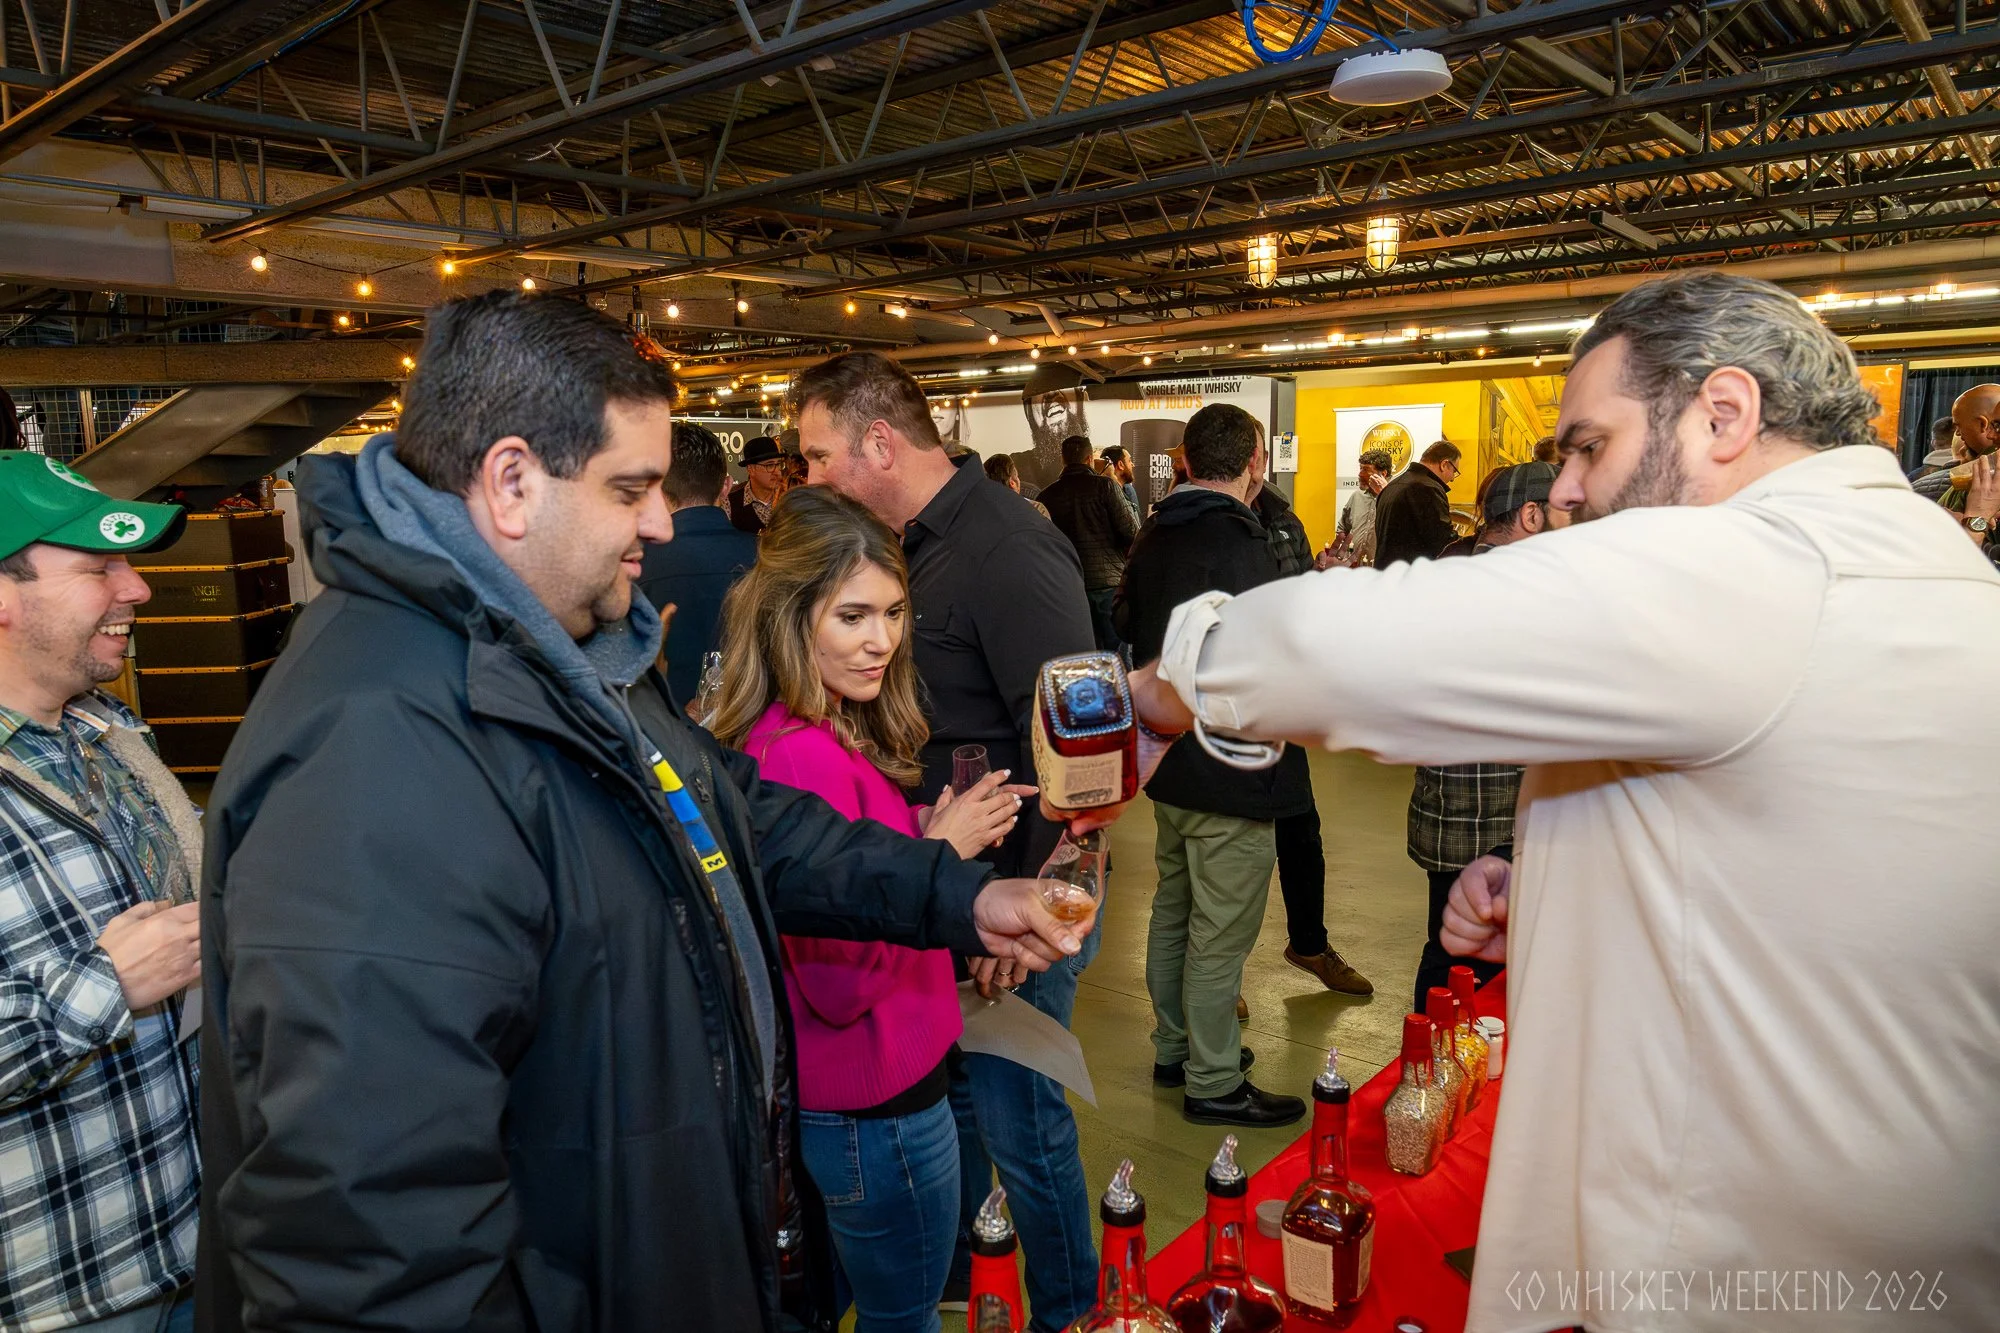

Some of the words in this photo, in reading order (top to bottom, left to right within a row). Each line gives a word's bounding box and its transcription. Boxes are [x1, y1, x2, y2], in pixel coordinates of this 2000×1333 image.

[1145, 384, 1176, 396] SINGLE
[1177, 383, 1203, 395] MALT
[1203, 381, 1242, 394] WHISKY
[1120, 399, 1145, 411] NOW
[1148, 397, 1161, 410] AT
[1165, 394, 1203, 409] JULIO'S
[1372, 429, 1403, 437] WHISKY
[1369, 440, 1392, 448] ICONS
[1393, 440, 1404, 448] OF
[102, 513, 135, 531] CELTICS
